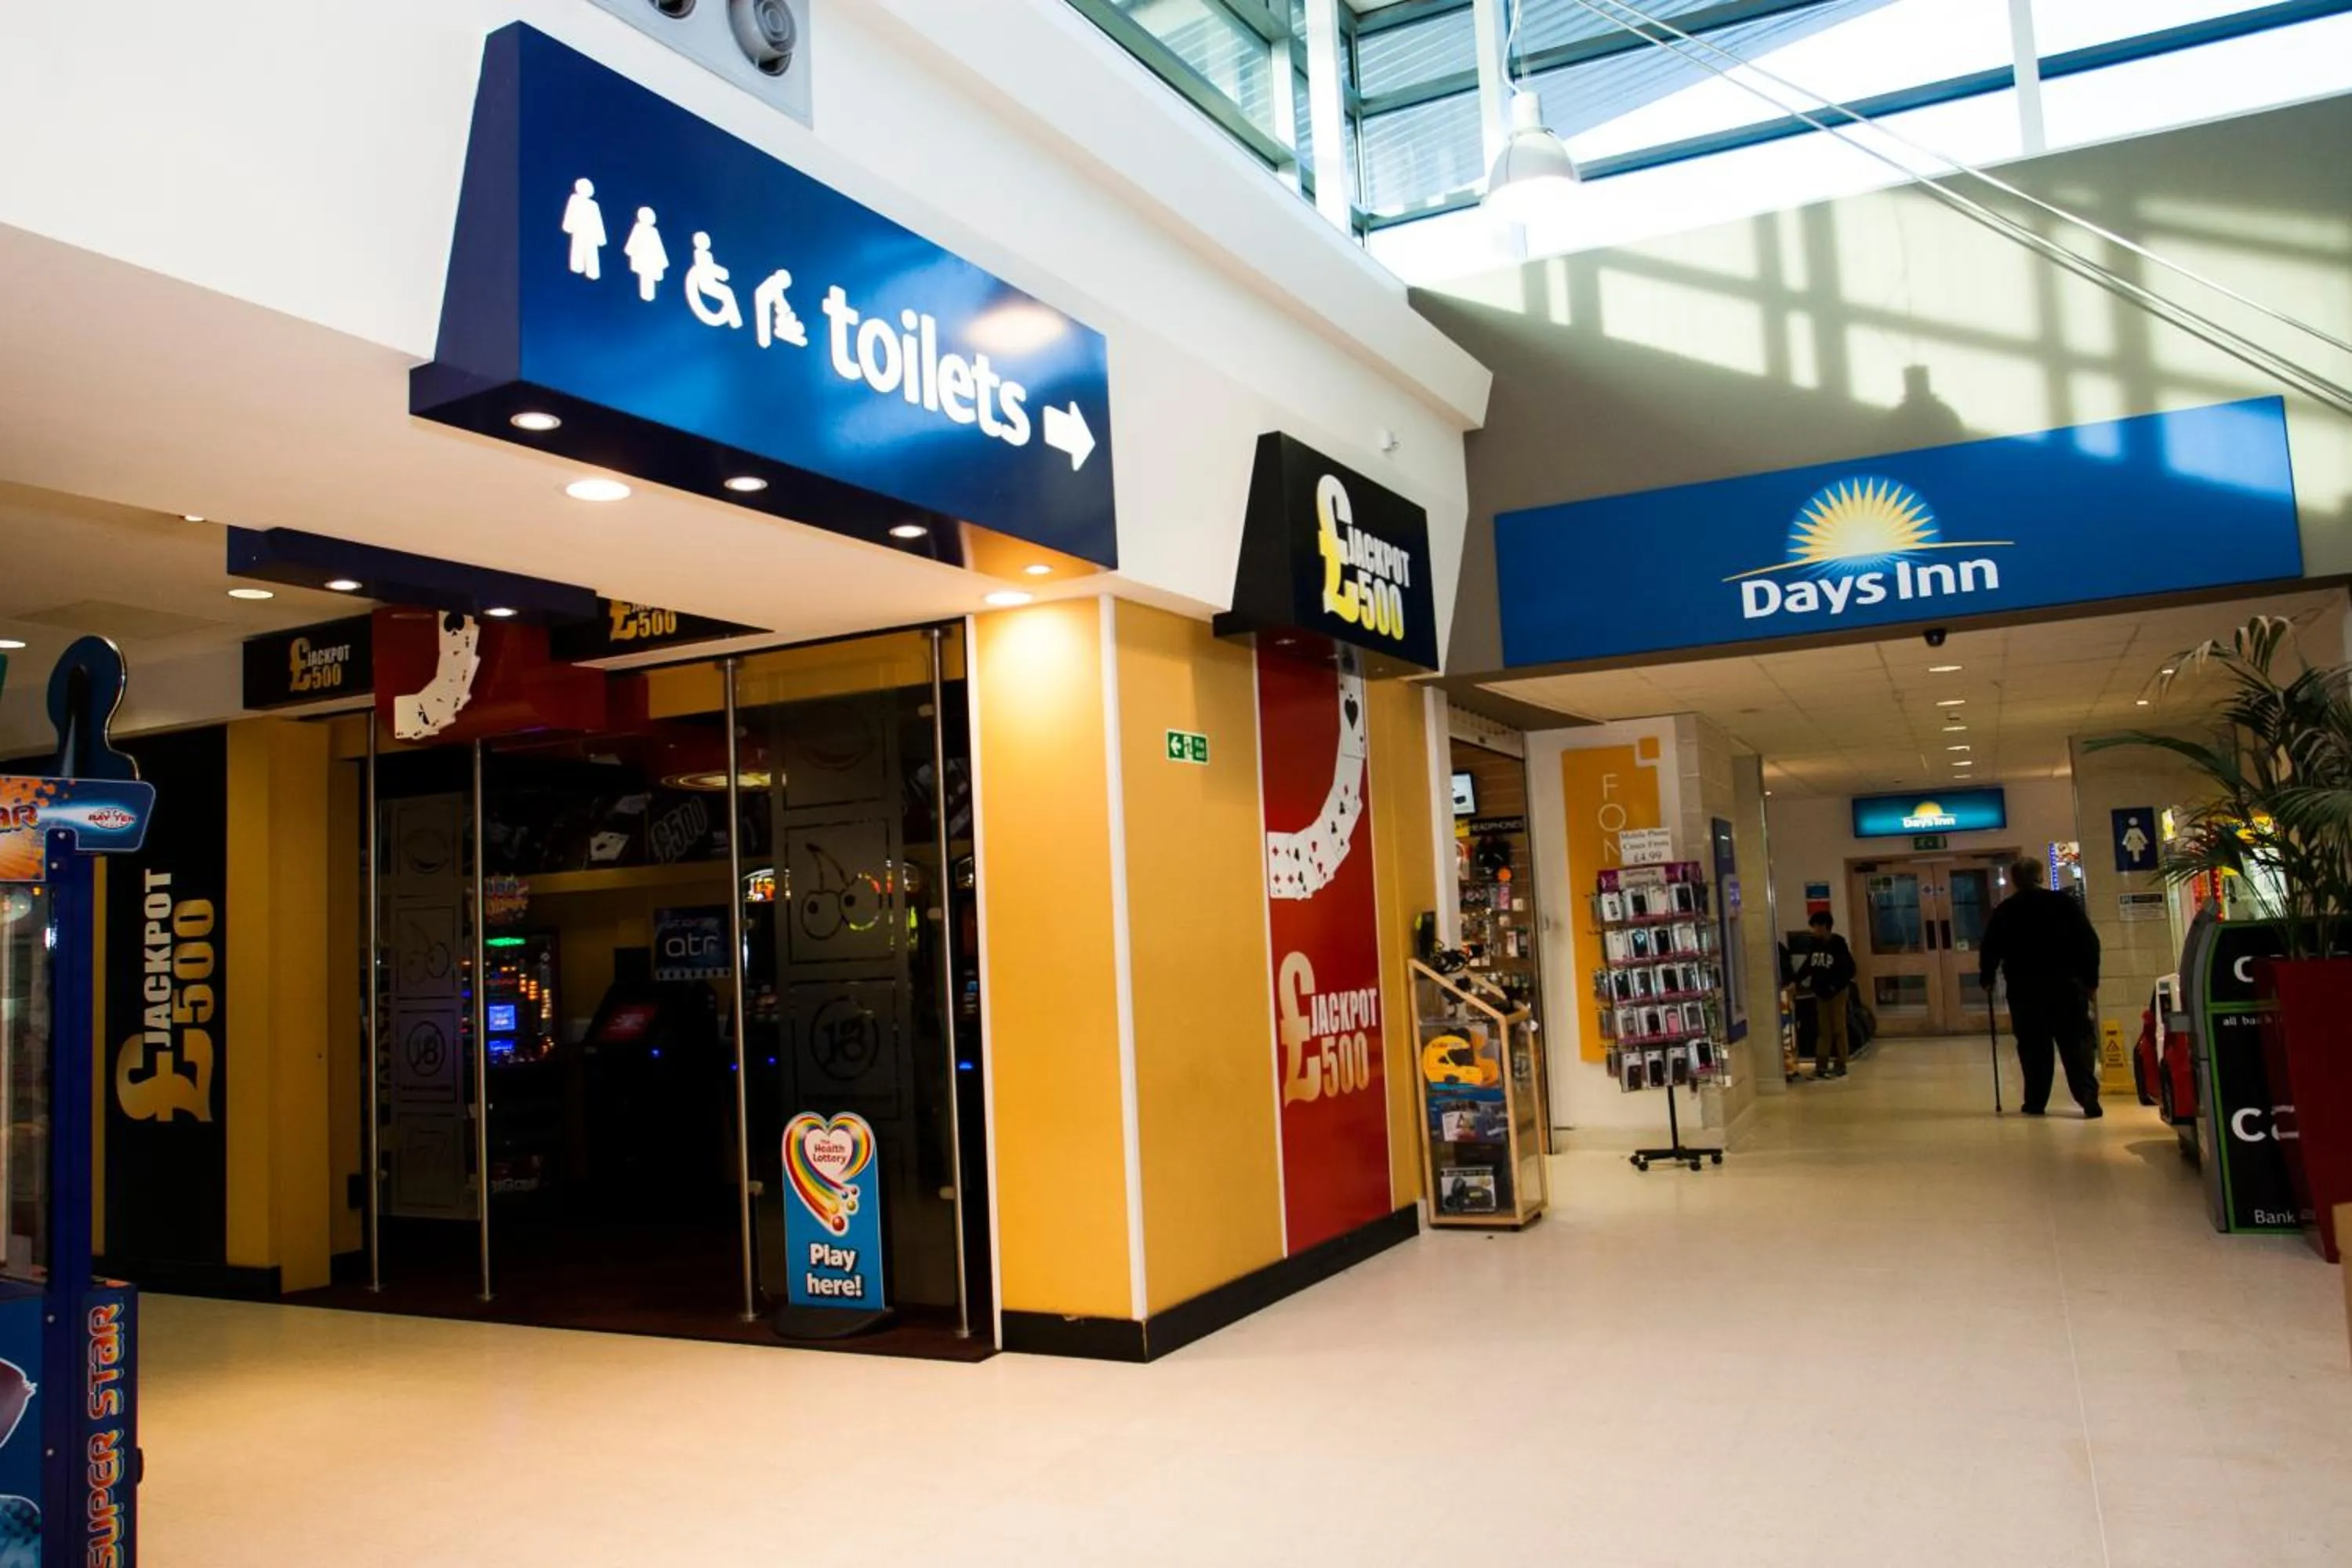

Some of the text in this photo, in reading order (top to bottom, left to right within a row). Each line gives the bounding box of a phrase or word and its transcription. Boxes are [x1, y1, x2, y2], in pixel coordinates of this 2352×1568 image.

[822, 285, 1031, 446] toilets
[1347, 525, 1410, 588] JACKPOT
[1740, 558, 1999, 619] Days Inn
[307, 644, 351, 667] JACKPOT
[1903, 815, 1956, 829] Days Inn
[665, 931, 718, 958] atr
[144, 868, 172, 1048] JACKPOT
[1810, 953, 1834, 968] GAP
[1310, 988, 1378, 1037] JACKPOT
[813, 1154, 847, 1166] Lottery
[814, 1144, 845, 1154] Health
[2253, 1208, 2296, 1225] Bank
[809, 1243, 856, 1271] Play
[806, 1272, 862, 1297] here!
